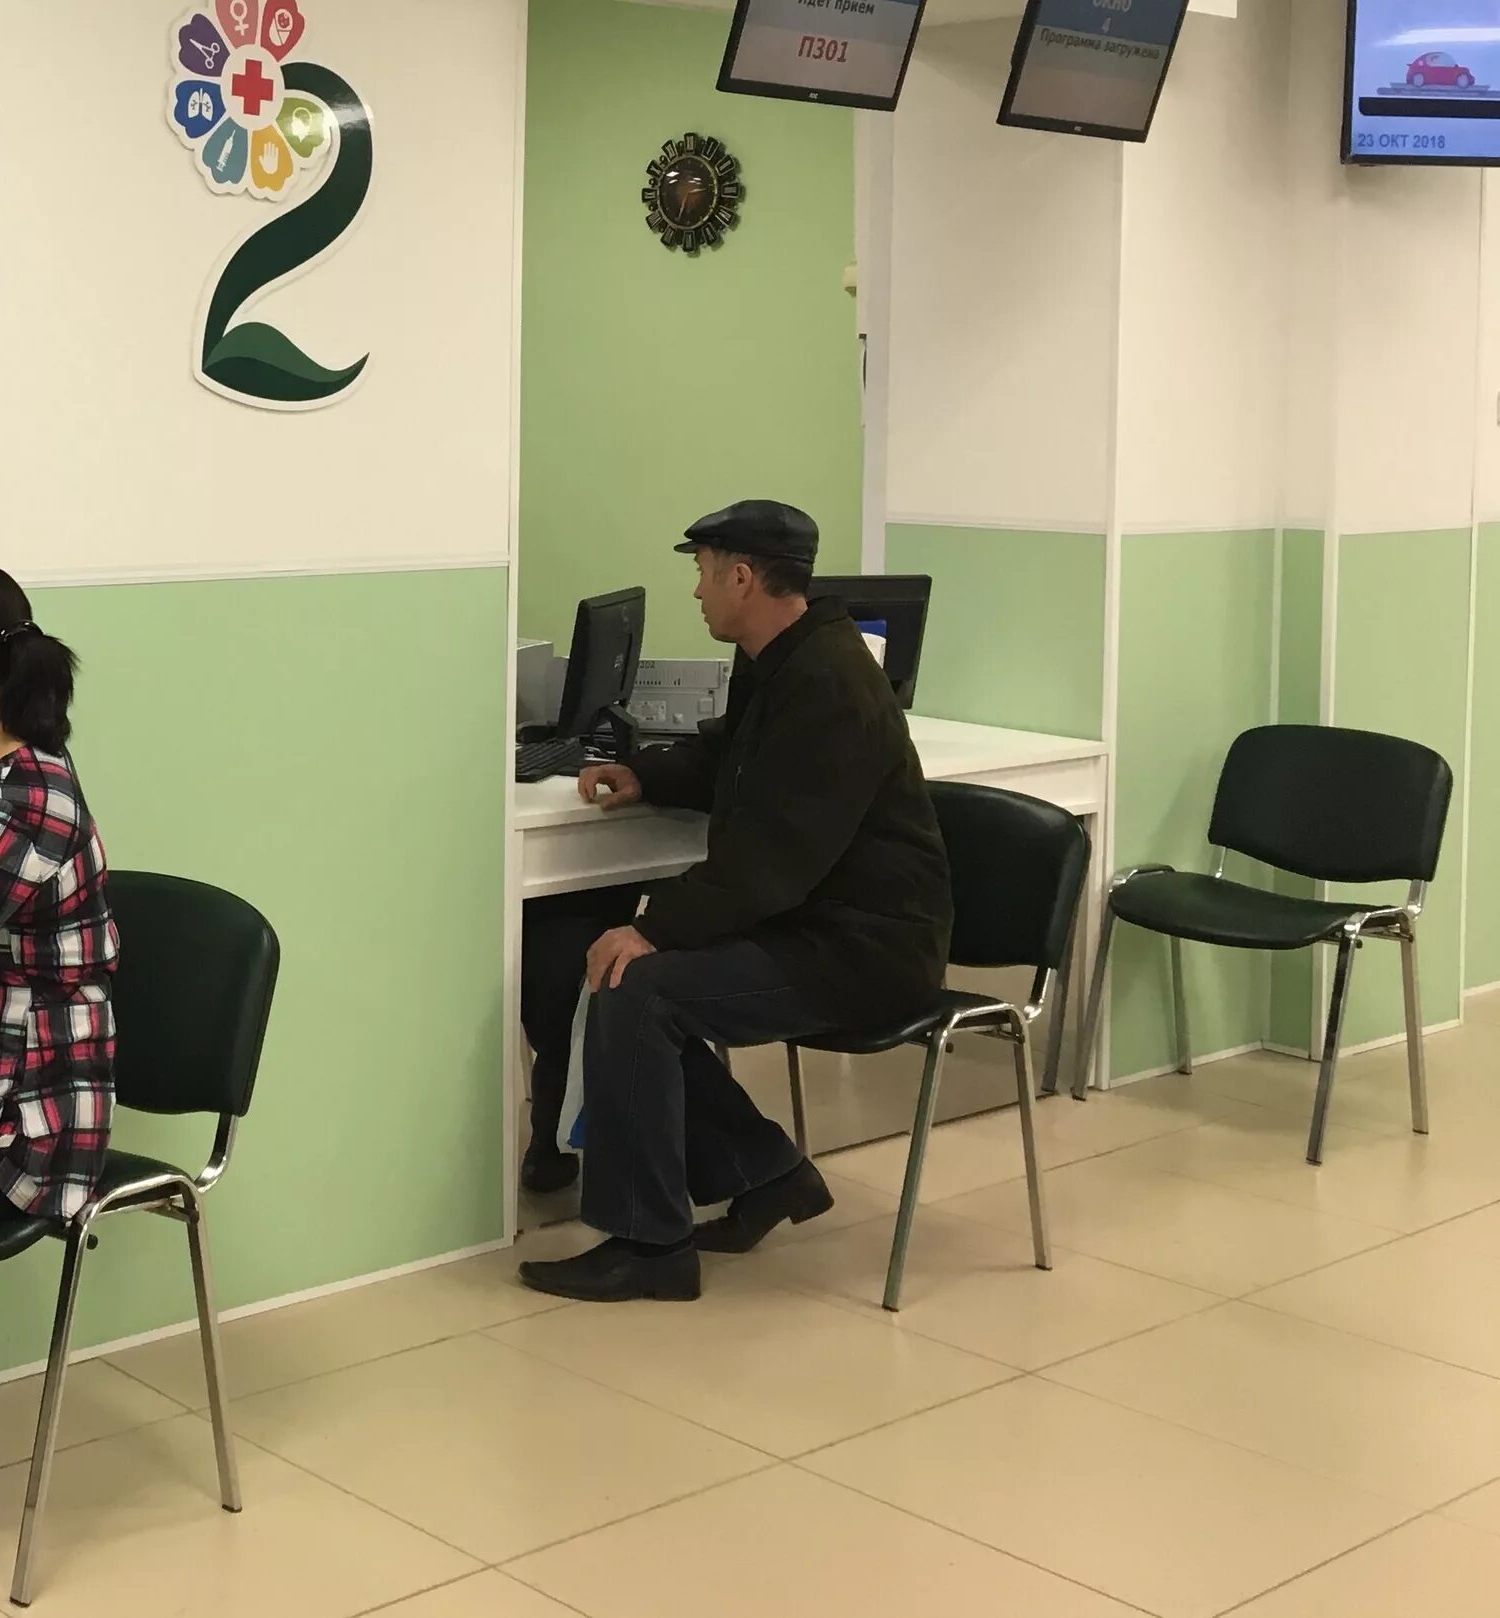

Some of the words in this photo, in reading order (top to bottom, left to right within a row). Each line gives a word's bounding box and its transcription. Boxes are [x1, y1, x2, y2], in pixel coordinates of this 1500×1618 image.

[798, 36, 848, 63] П301
[1357, 133, 1374, 147] 23
[1379, 134, 1409, 148] ОКТ
[1412, 135, 1446, 149] 2018
